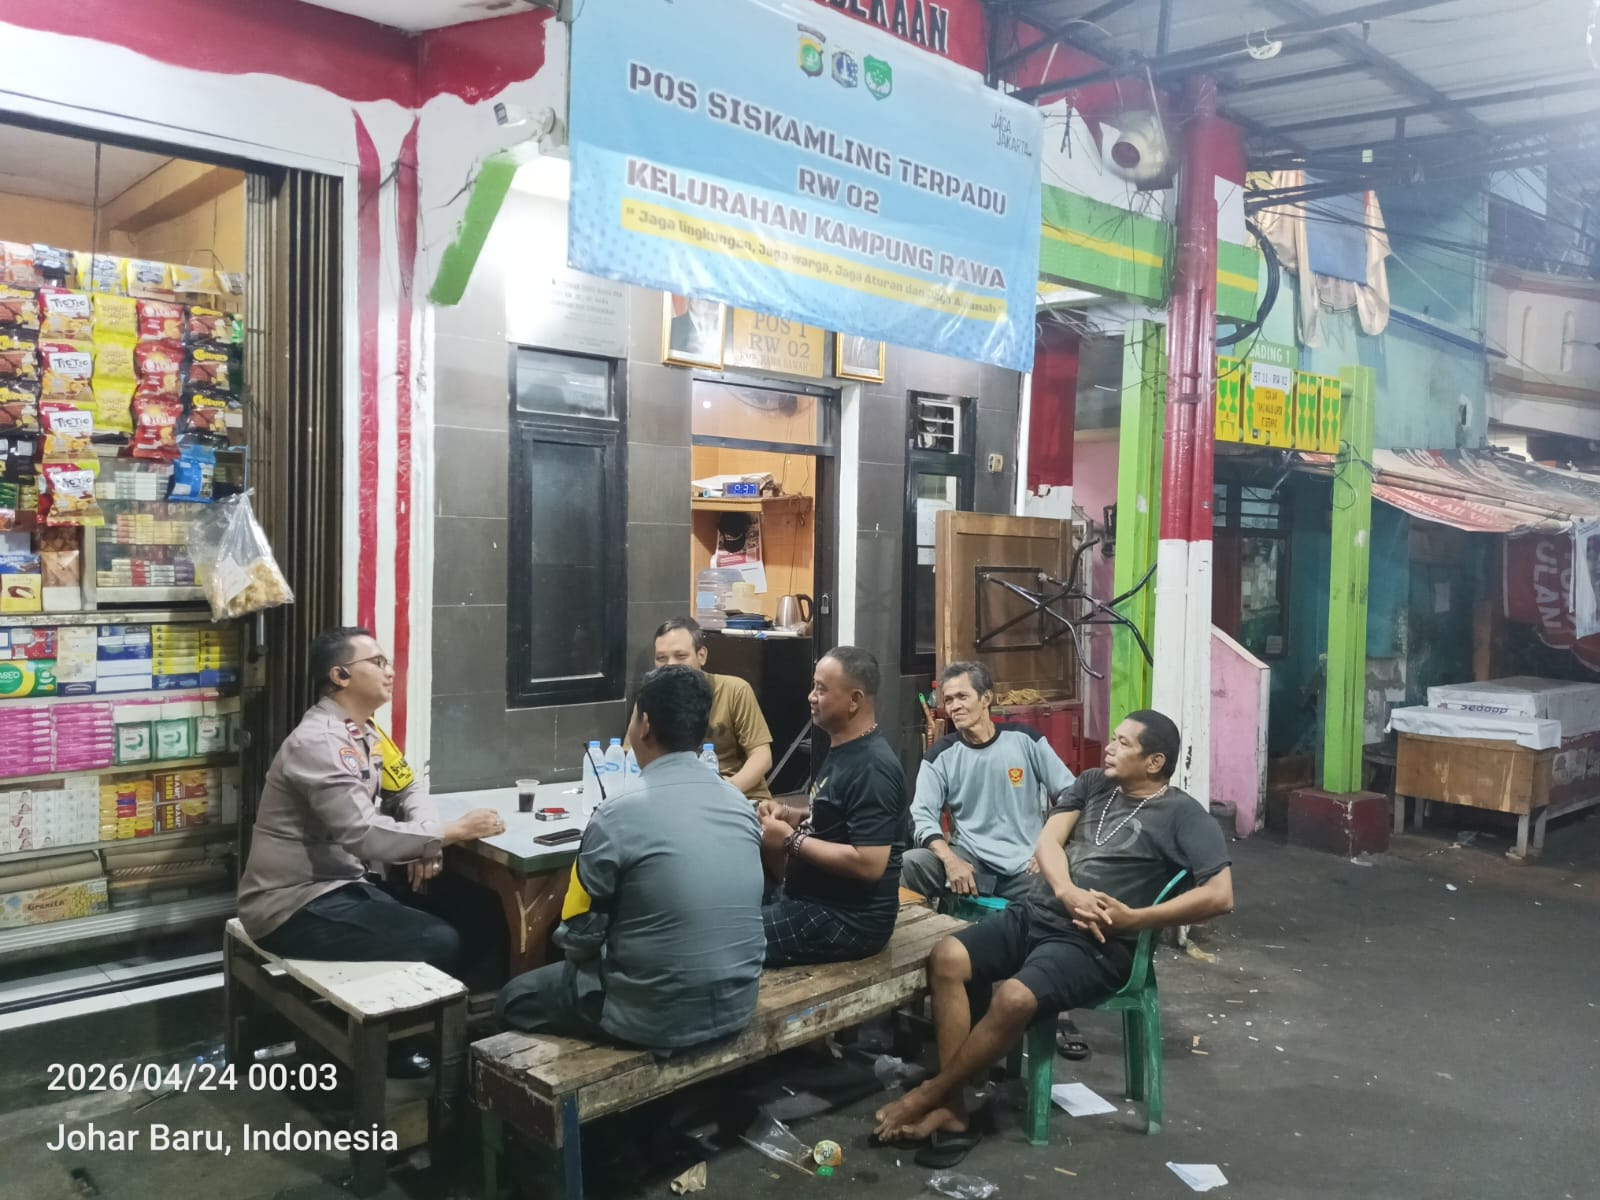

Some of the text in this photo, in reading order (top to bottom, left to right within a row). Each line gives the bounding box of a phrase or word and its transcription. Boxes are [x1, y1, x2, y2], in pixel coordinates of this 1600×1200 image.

[629, 62, 1008, 216] POS SISKAMLING TERPADU
[627, 159, 1007, 289] KELURAHAN KAMPUNG RAWA
[799, 167, 880, 215] RW 02
[638, 210, 677, 232] Jaga
[791, 255, 833, 276] warga,
[834, 264, 863, 283] Jaga
[864, 274, 904, 293] Aturan
[905, 284, 926, 298] dan
[749, 333, 810, 359] RW 02
